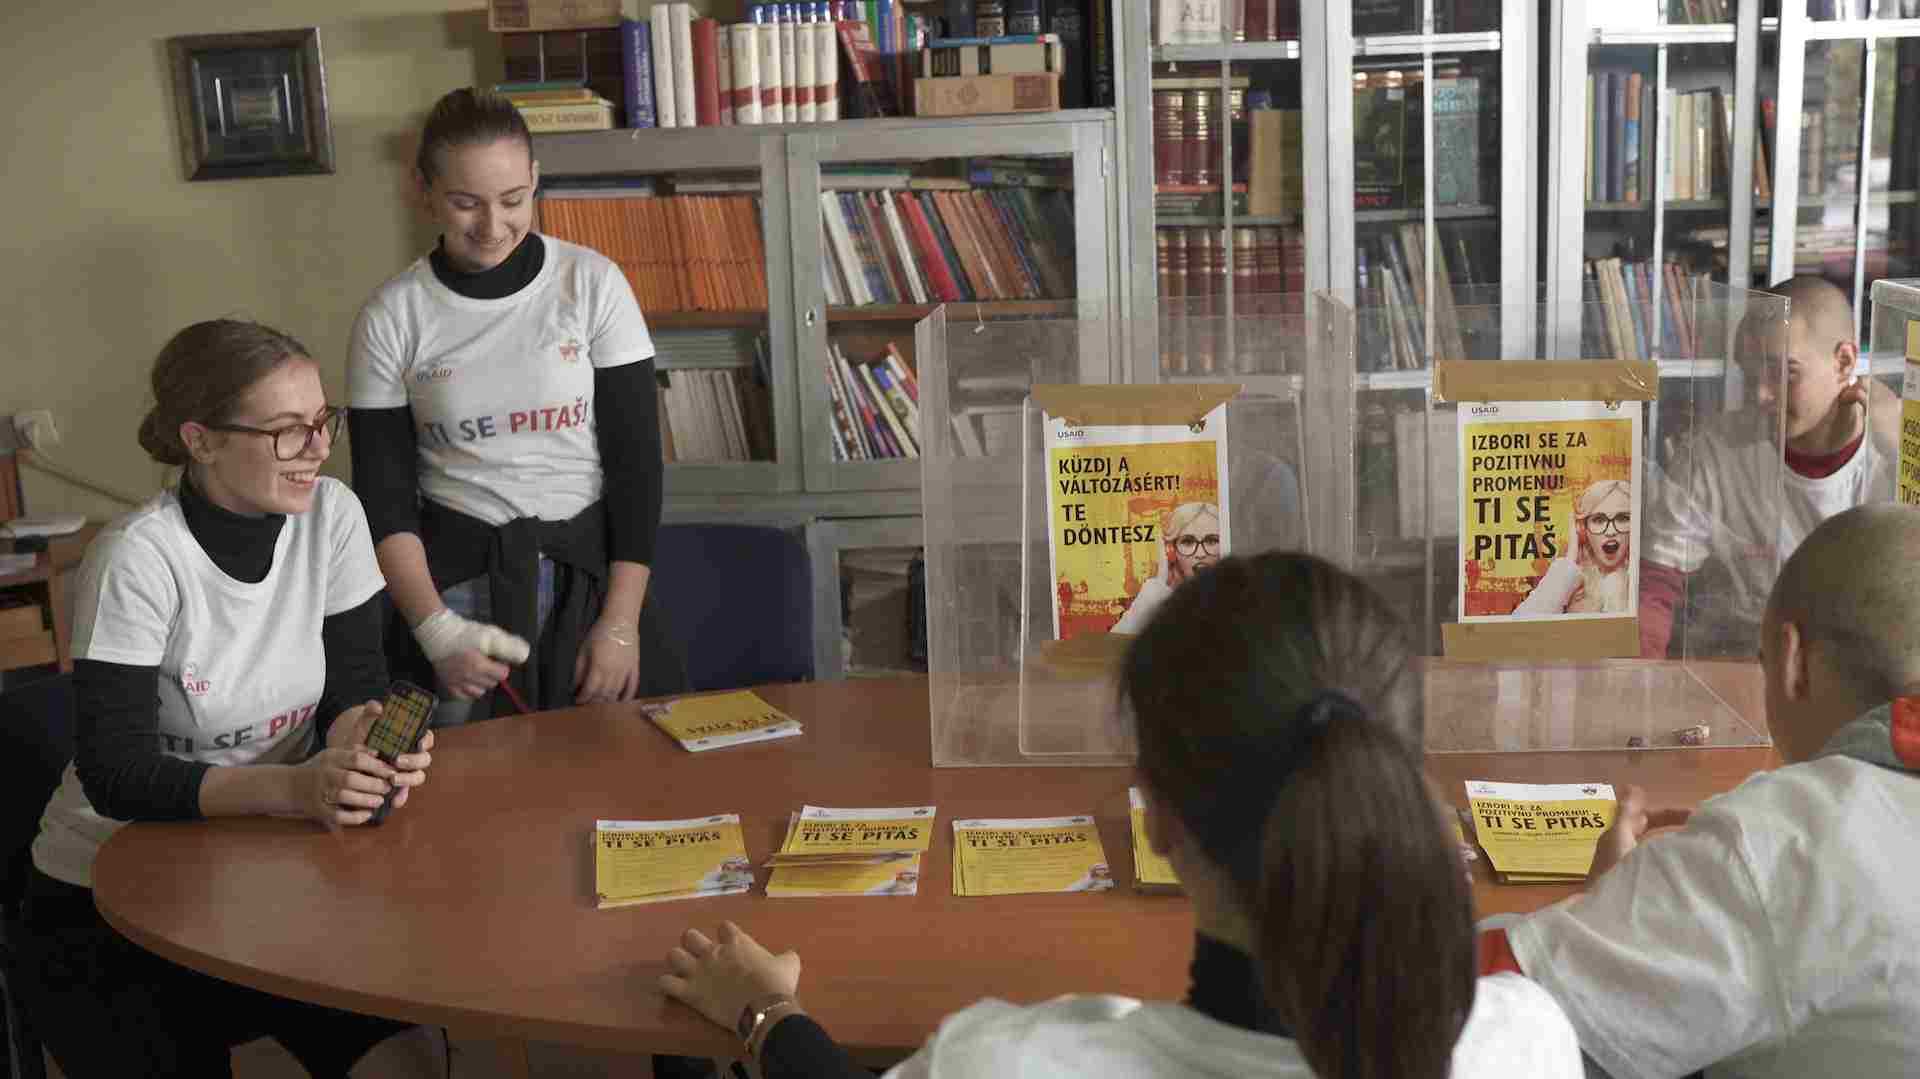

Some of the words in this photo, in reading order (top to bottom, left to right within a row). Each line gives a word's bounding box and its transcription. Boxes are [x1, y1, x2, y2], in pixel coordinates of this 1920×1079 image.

[424, 422, 450, 443] TI
[459, 415, 497, 442] SE
[509, 395, 588, 433] PITAŠ!
[1471, 406, 1499, 415] USAID
[1057, 430, 1085, 438] USAID
[1472, 434, 1530, 450] IZBORI
[1538, 433, 1558, 449] SE
[1566, 432, 1587, 447] ZA
[1059, 454, 1112, 475] KÜZDJ
[1119, 456, 1129, 472] A
[1472, 453, 1566, 472] POZITIVNU
[1060, 473, 1181, 495] VÁLTOZÁSÉRT!
[1473, 475, 1565, 493] PROMENU!
[1061, 504, 1086, 522] TE
[1473, 497, 1501, 524] TI
[1516, 496, 1550, 523] SE
[1063, 524, 1155, 546] DÖNTESZ
[1475, 524, 1557, 561] PITAŠ
[160, 733, 193, 753] TI
[214, 726, 253, 750] SE
[1481, 816, 1503, 828] TI
[1511, 817, 1536, 830] SE
[1544, 813, 1605, 829] PITAŠ
[802, 832, 819, 841] TI
[830, 832, 853, 841] SE
